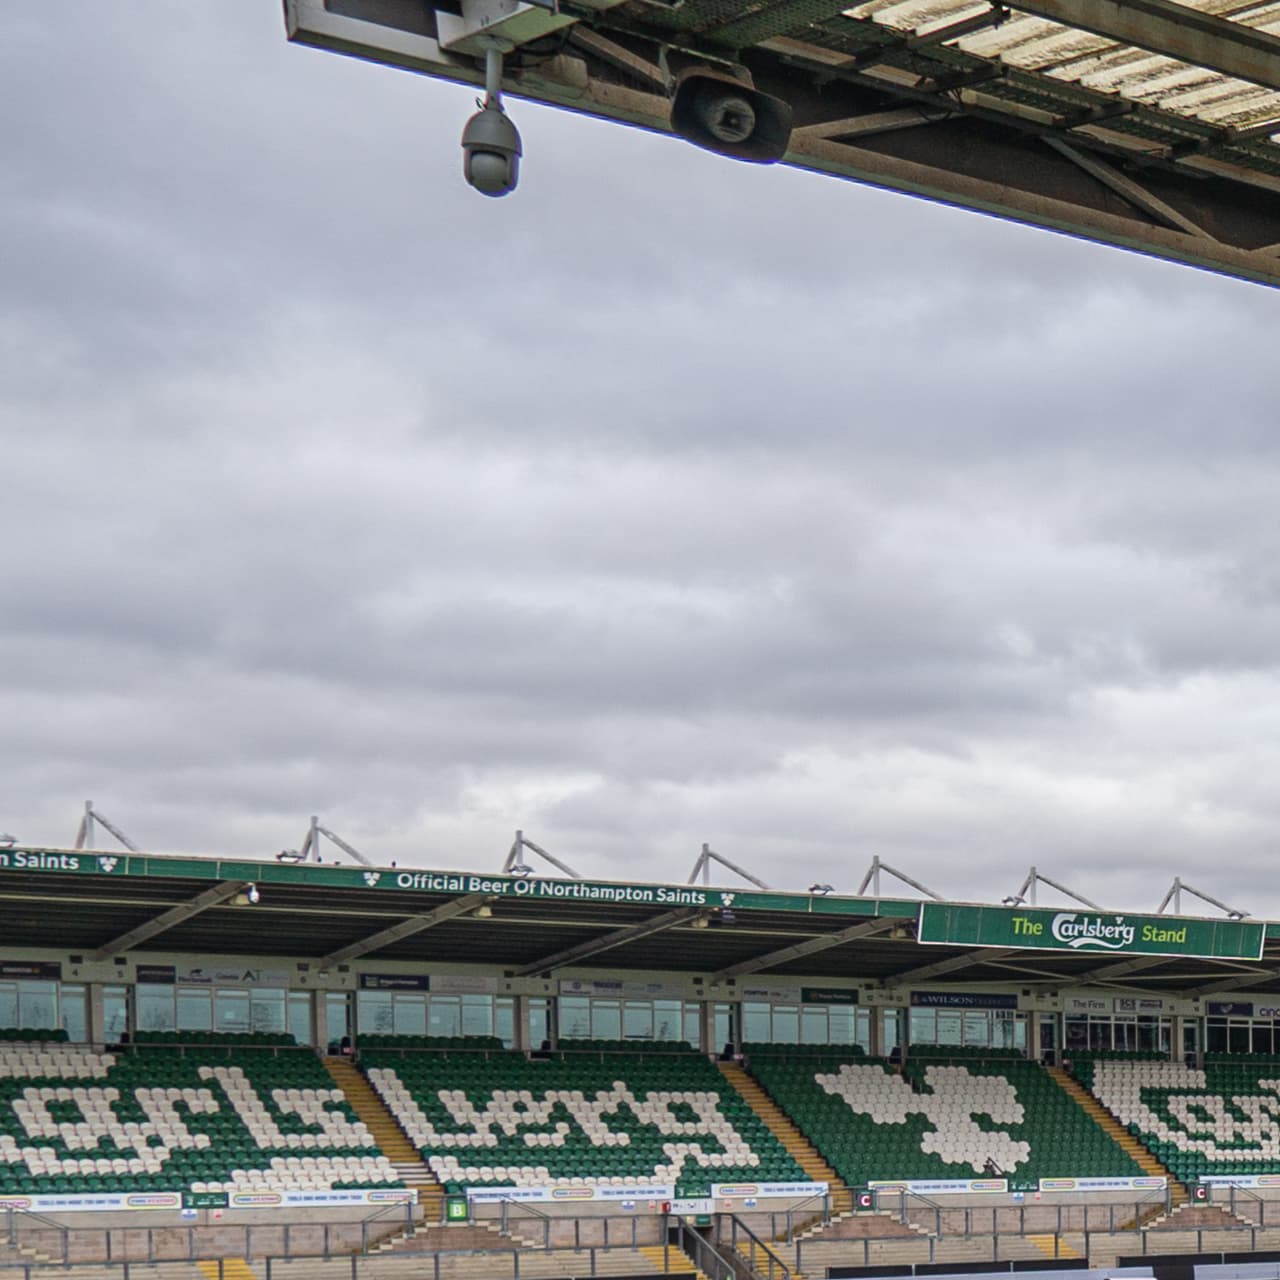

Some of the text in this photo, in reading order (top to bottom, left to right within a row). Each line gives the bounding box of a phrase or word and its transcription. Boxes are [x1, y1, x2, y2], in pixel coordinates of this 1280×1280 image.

[15, 851, 79, 871] Saints
[397, 873, 706, 905] Official Beer Of Northampton Saints
[1012, 912, 1186, 948] The Carlsberg Stand
[1073, 1000, 1086, 1009] The
[1088, 1000, 1106, 1009] Firm
[860, 1194, 872, 1206] C
[1196, 1187, 1206, 1199] C
[452, 1203, 462, 1217] B
